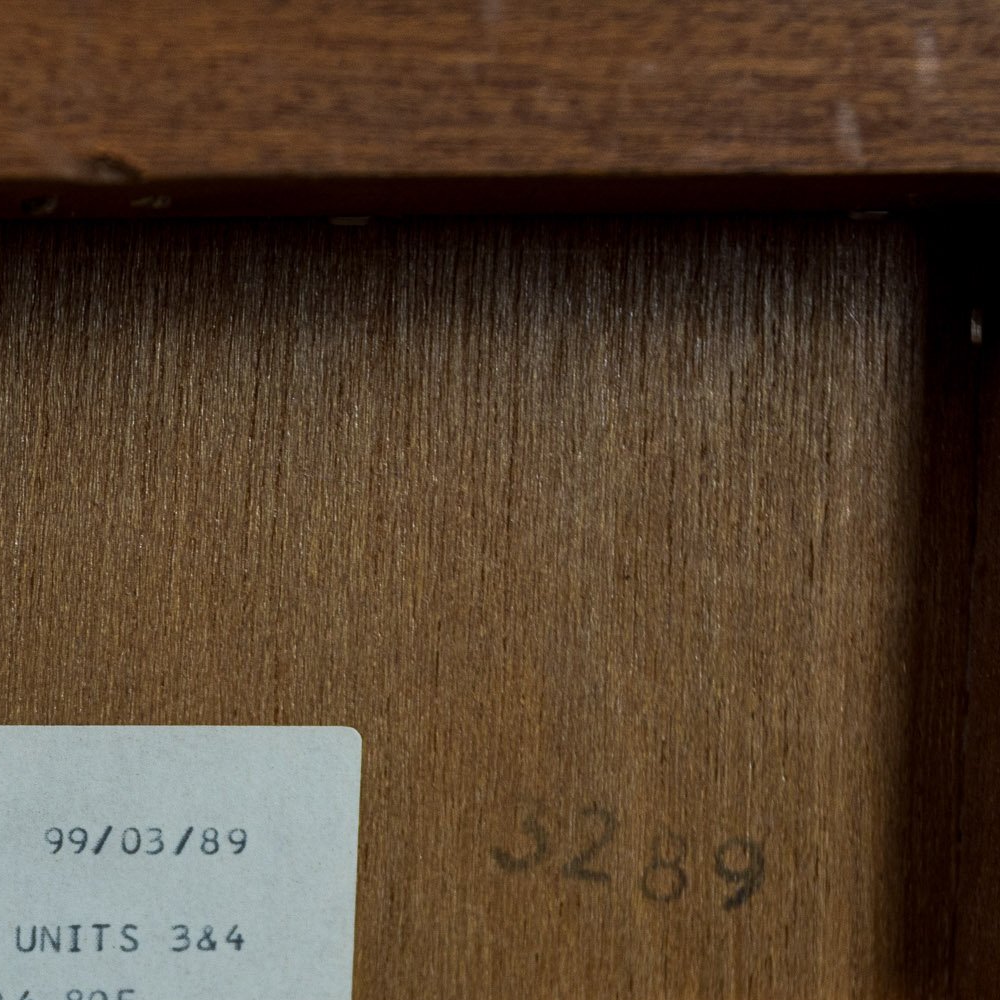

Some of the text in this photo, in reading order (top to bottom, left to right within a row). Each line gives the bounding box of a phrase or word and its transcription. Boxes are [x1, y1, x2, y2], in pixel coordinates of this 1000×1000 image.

[44, 824, 248, 857] 99/03/89
[15, 922, 140, 954] UNITS
[170, 923, 246, 954] 3&4
